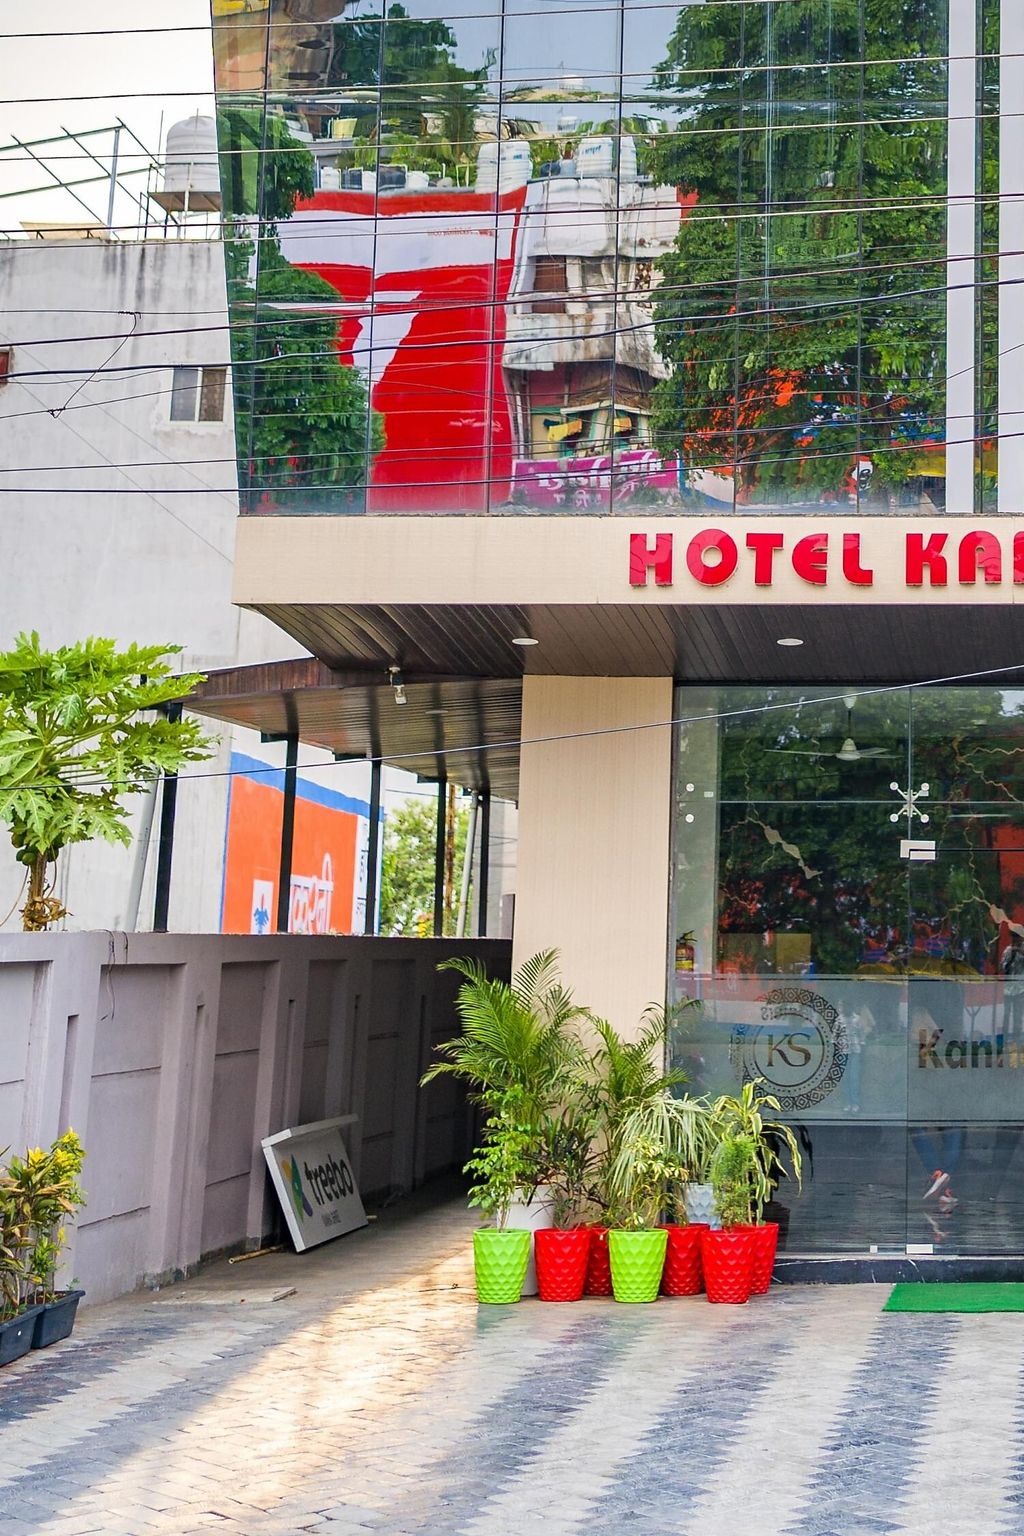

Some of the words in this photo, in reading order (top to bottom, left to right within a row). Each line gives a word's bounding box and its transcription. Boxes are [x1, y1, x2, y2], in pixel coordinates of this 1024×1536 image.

[629, 529, 874, 587] HOTEL
[766, 1032, 812, 1067] KS
[304, 1153, 354, 1206] treebo
